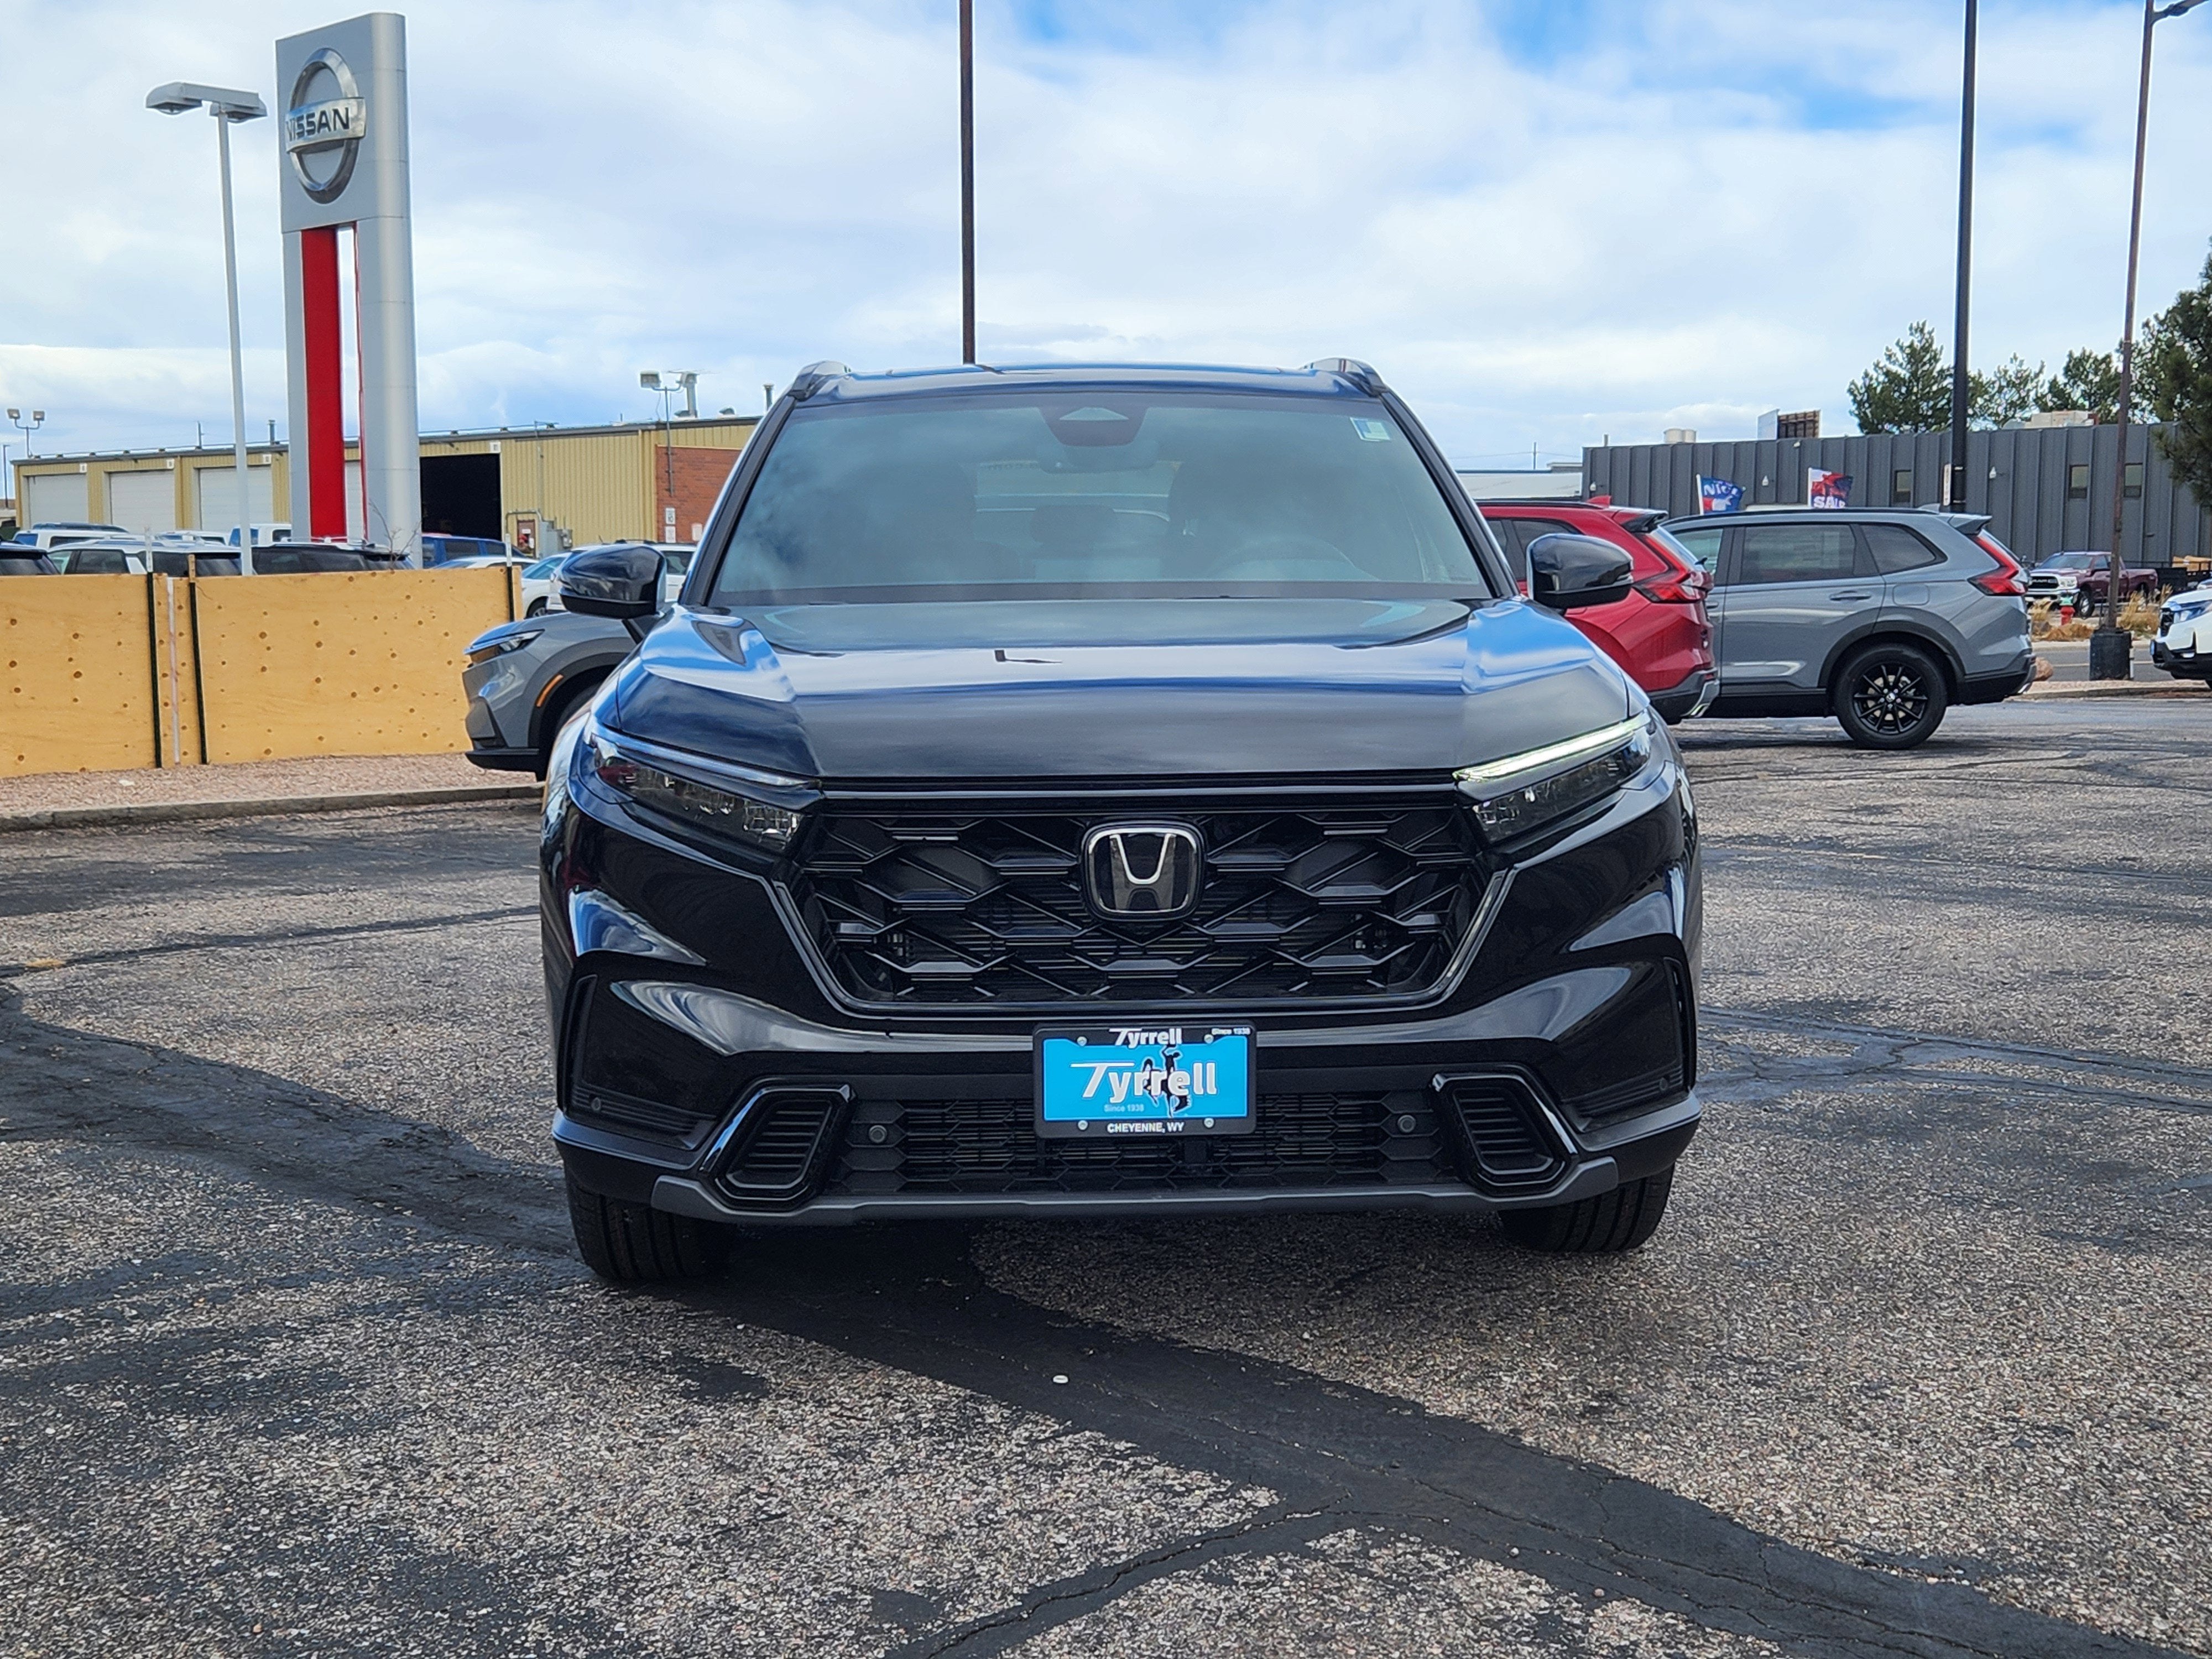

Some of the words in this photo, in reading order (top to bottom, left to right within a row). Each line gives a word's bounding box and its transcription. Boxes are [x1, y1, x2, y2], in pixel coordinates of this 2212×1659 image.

[286, 107, 350, 142] NISSAN
[1109, 1028, 1182, 1049] Tyrrell
[1071, 1062, 1217, 1103] Tyrrell
[1107, 1122, 1166, 1133] CHEYENNE,
[1167, 1121, 1185, 1132] WY
